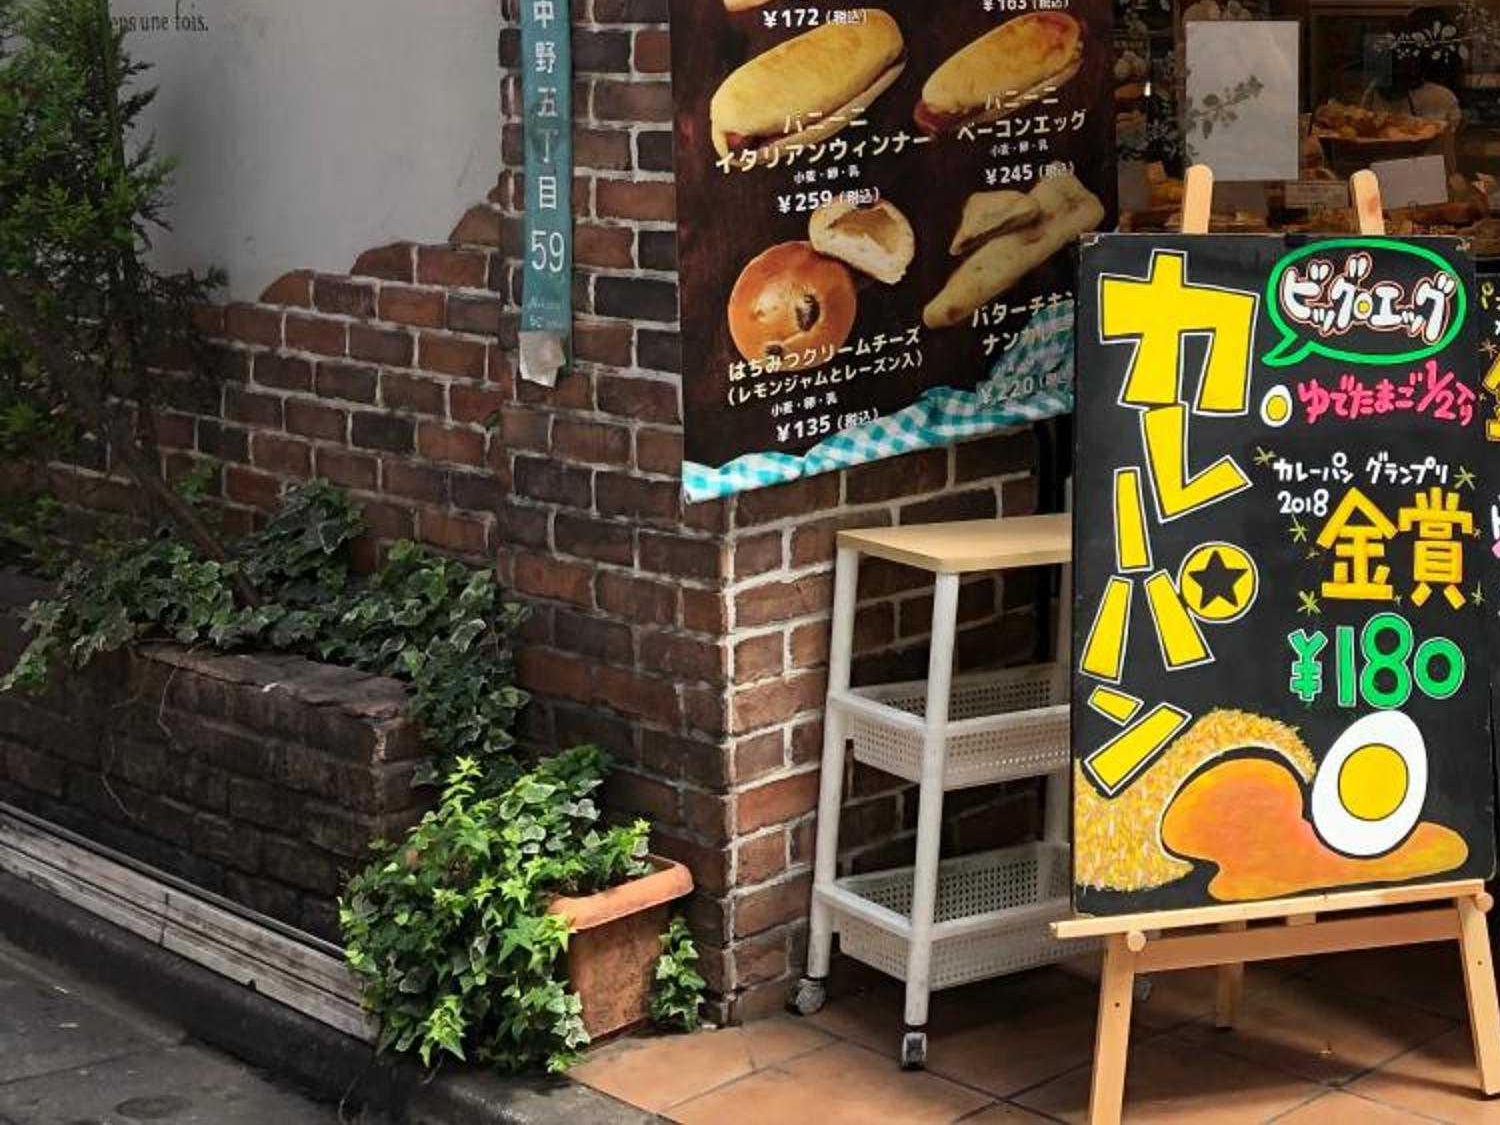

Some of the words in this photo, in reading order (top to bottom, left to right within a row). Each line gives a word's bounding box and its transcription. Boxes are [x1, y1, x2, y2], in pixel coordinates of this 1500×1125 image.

[141, 13, 169, 32] une
[763, 9, 820, 29] ¥172
[985, 88, 1059, 109] パニーニ
[784, 106, 869, 134] パニーニ
[957, 109, 1087, 142] ベーコンエッグ
[715, 130, 932, 175] イタリアンウィンナー
[985, 163, 1033, 185] ¥245
[777, 191, 833, 214] ¥259
[530, 230, 565, 272] 59
[728, 325, 921, 383] はちみつクリームチーズ
[776, 415, 832, 442] ¥135
[1273, 452, 1354, 484] カレーパン
[1366, 451, 1449, 485] グランプリ
[1278, 488, 1329, 516] 2018
[1079, 249, 1260, 797] カレーパン
[1316, 486, 1474, 611] 金賞
[1287, 612, 1466, 709] ¥180
